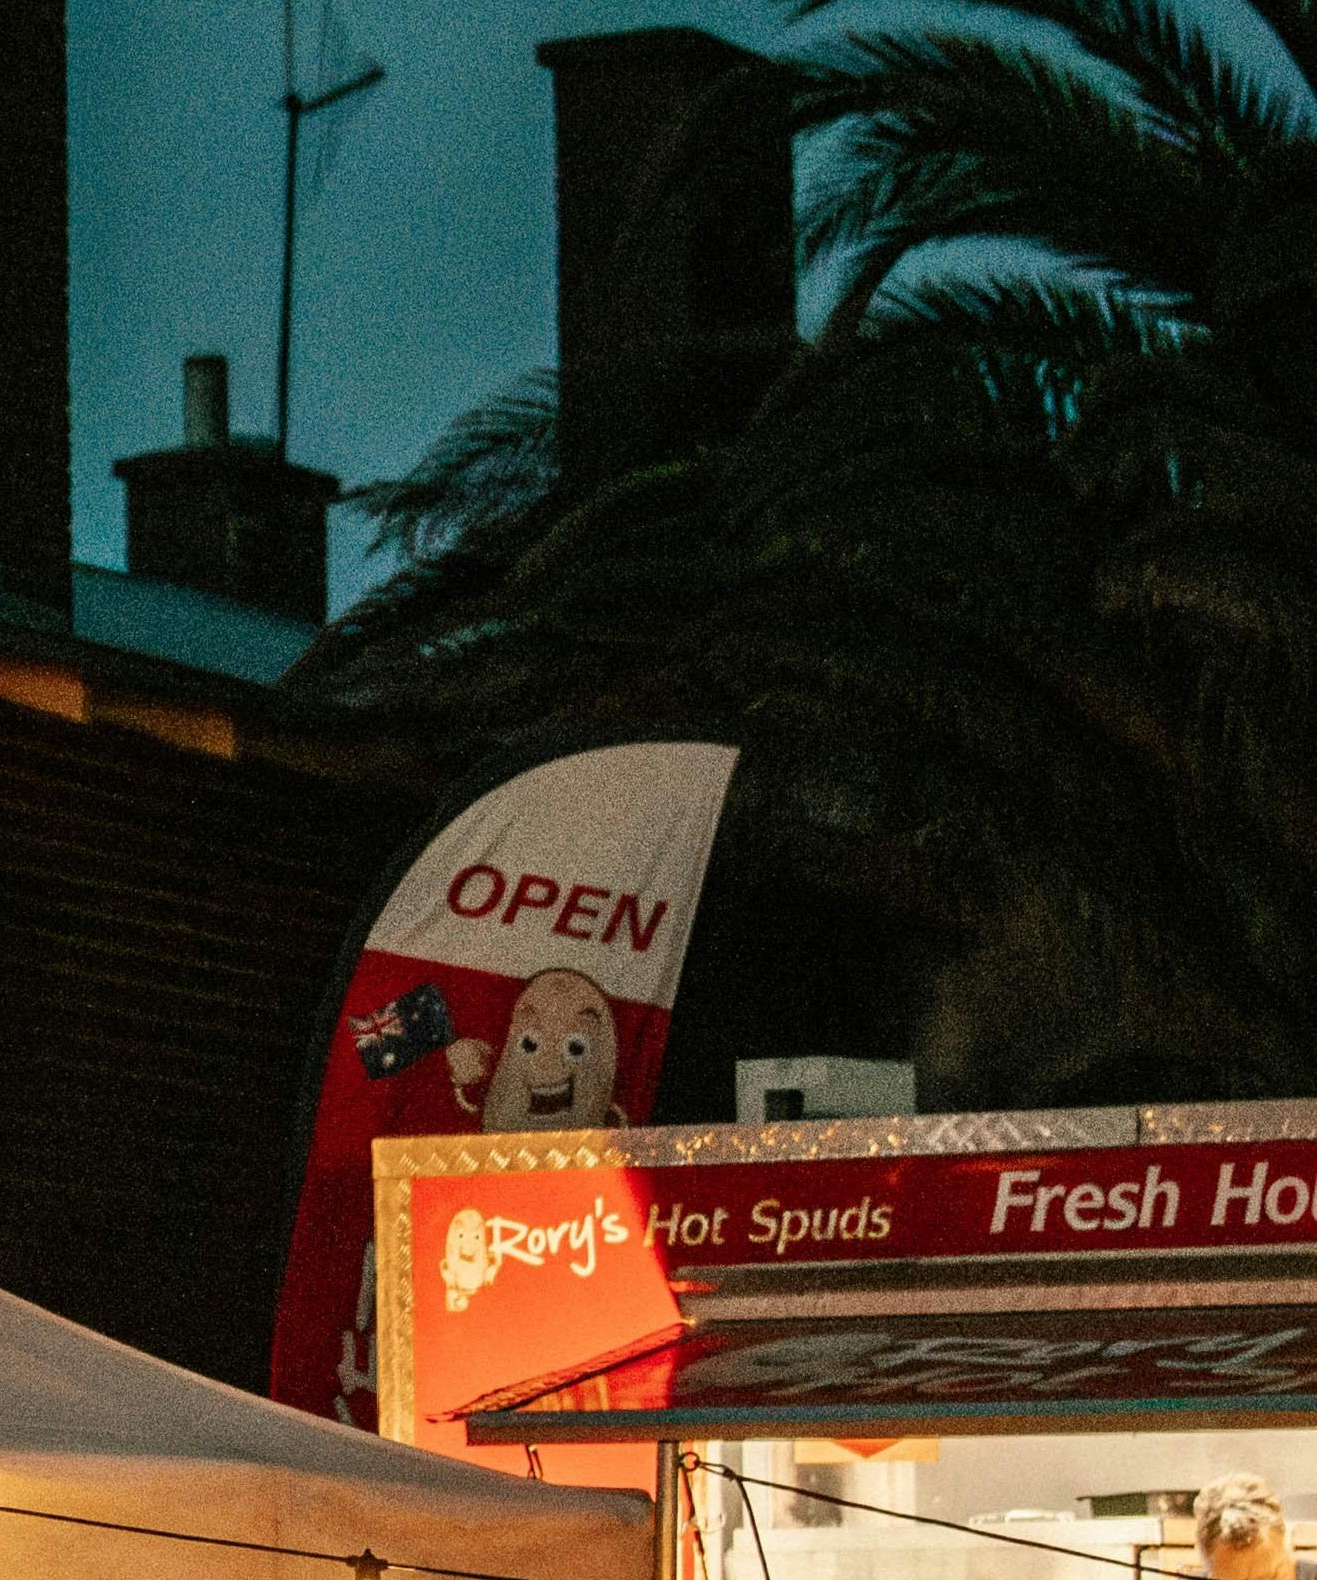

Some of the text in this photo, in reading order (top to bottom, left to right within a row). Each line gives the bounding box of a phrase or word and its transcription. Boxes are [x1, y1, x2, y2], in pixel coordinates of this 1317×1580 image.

[447, 863, 668, 953] OPEN
[485, 1196, 893, 1277] Rory's Hot Spuds
[989, 1161, 1317, 1235] Fresh Ho
